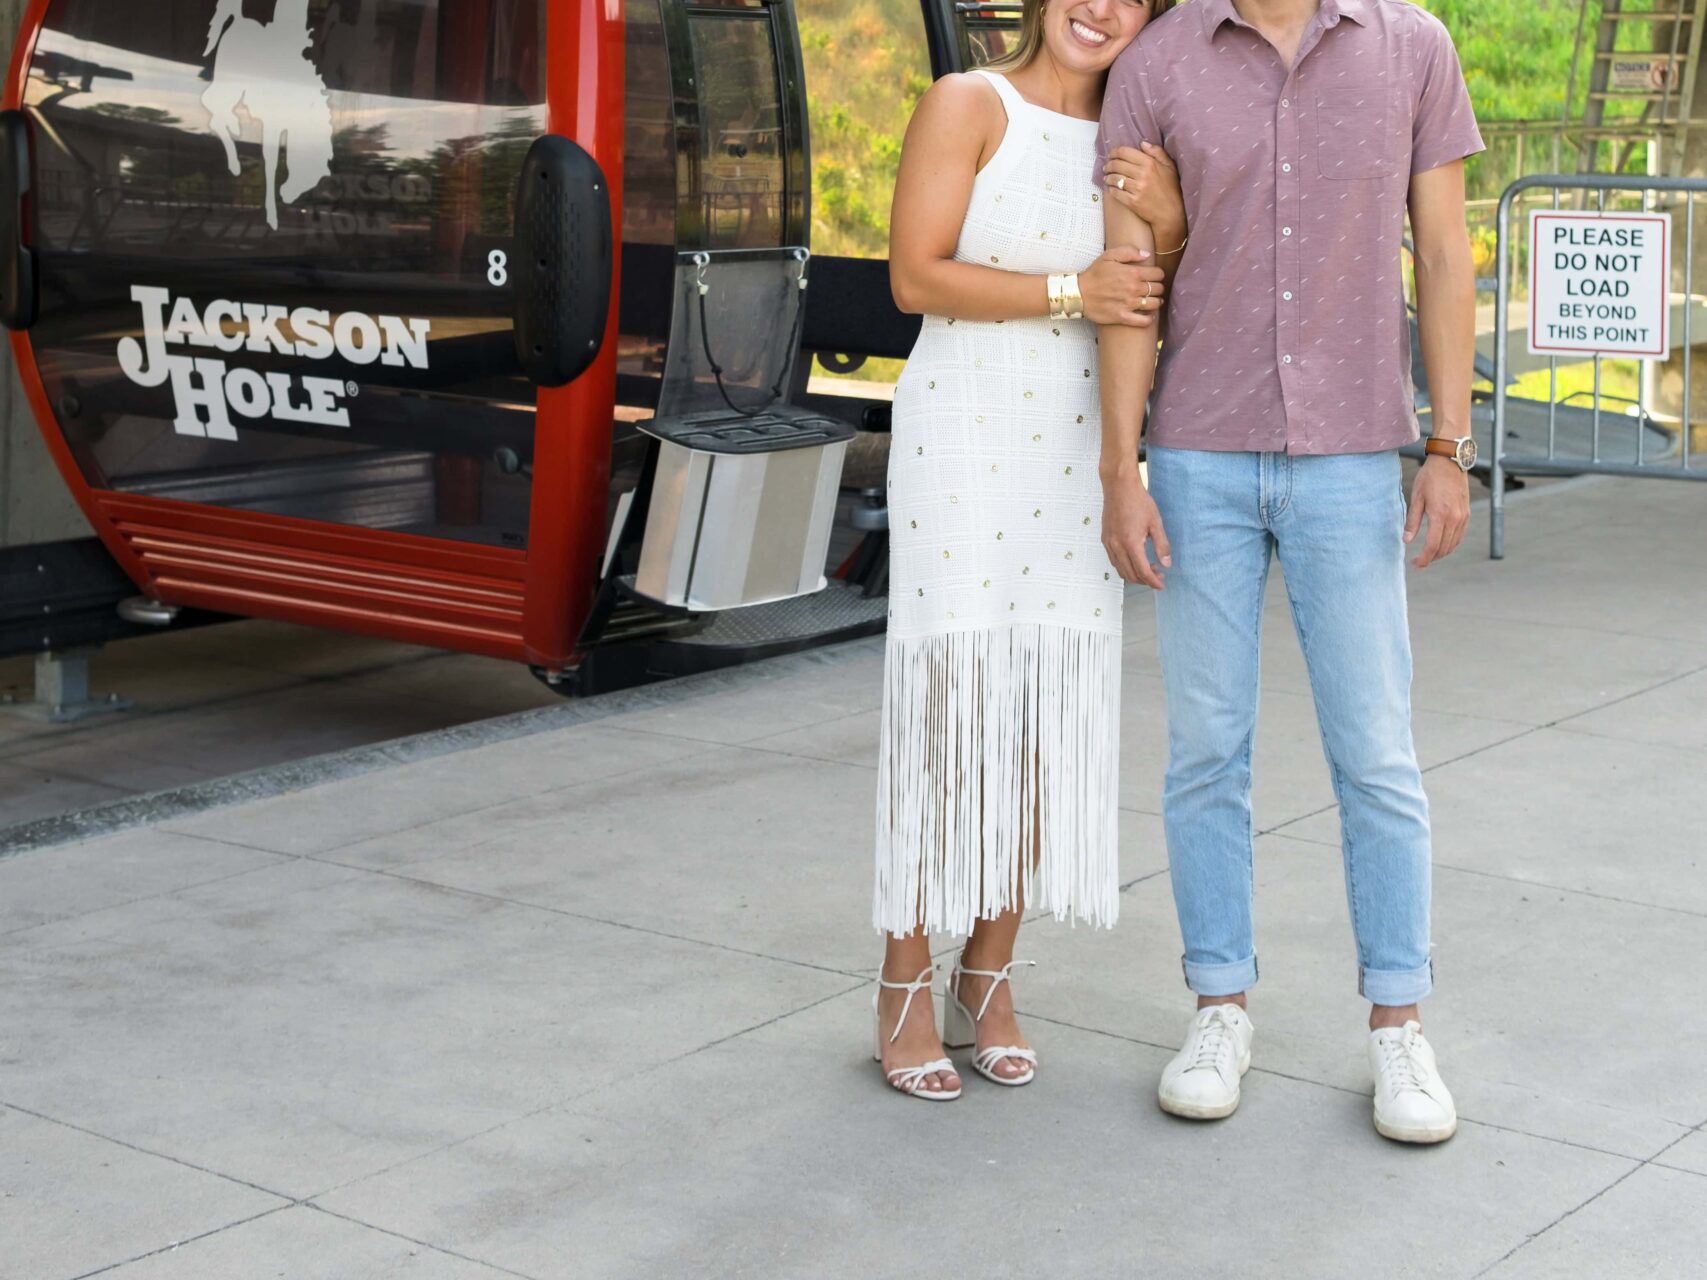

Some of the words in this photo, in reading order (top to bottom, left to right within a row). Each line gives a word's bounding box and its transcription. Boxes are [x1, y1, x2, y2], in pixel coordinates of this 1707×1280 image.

[1554, 227, 1644, 247] PLEASE
[487, 249, 508, 287] 8
[1555, 253, 1587, 271] DO
[1595, 254, 1643, 272] NOT
[1566, 278, 1630, 298] LOAD
[1559, 303, 1637, 320] BEYOND
[117, 285, 430, 387] JACKSON
[1547, 324, 1587, 340] THIS
[1594, 327, 1649, 343] POINT
